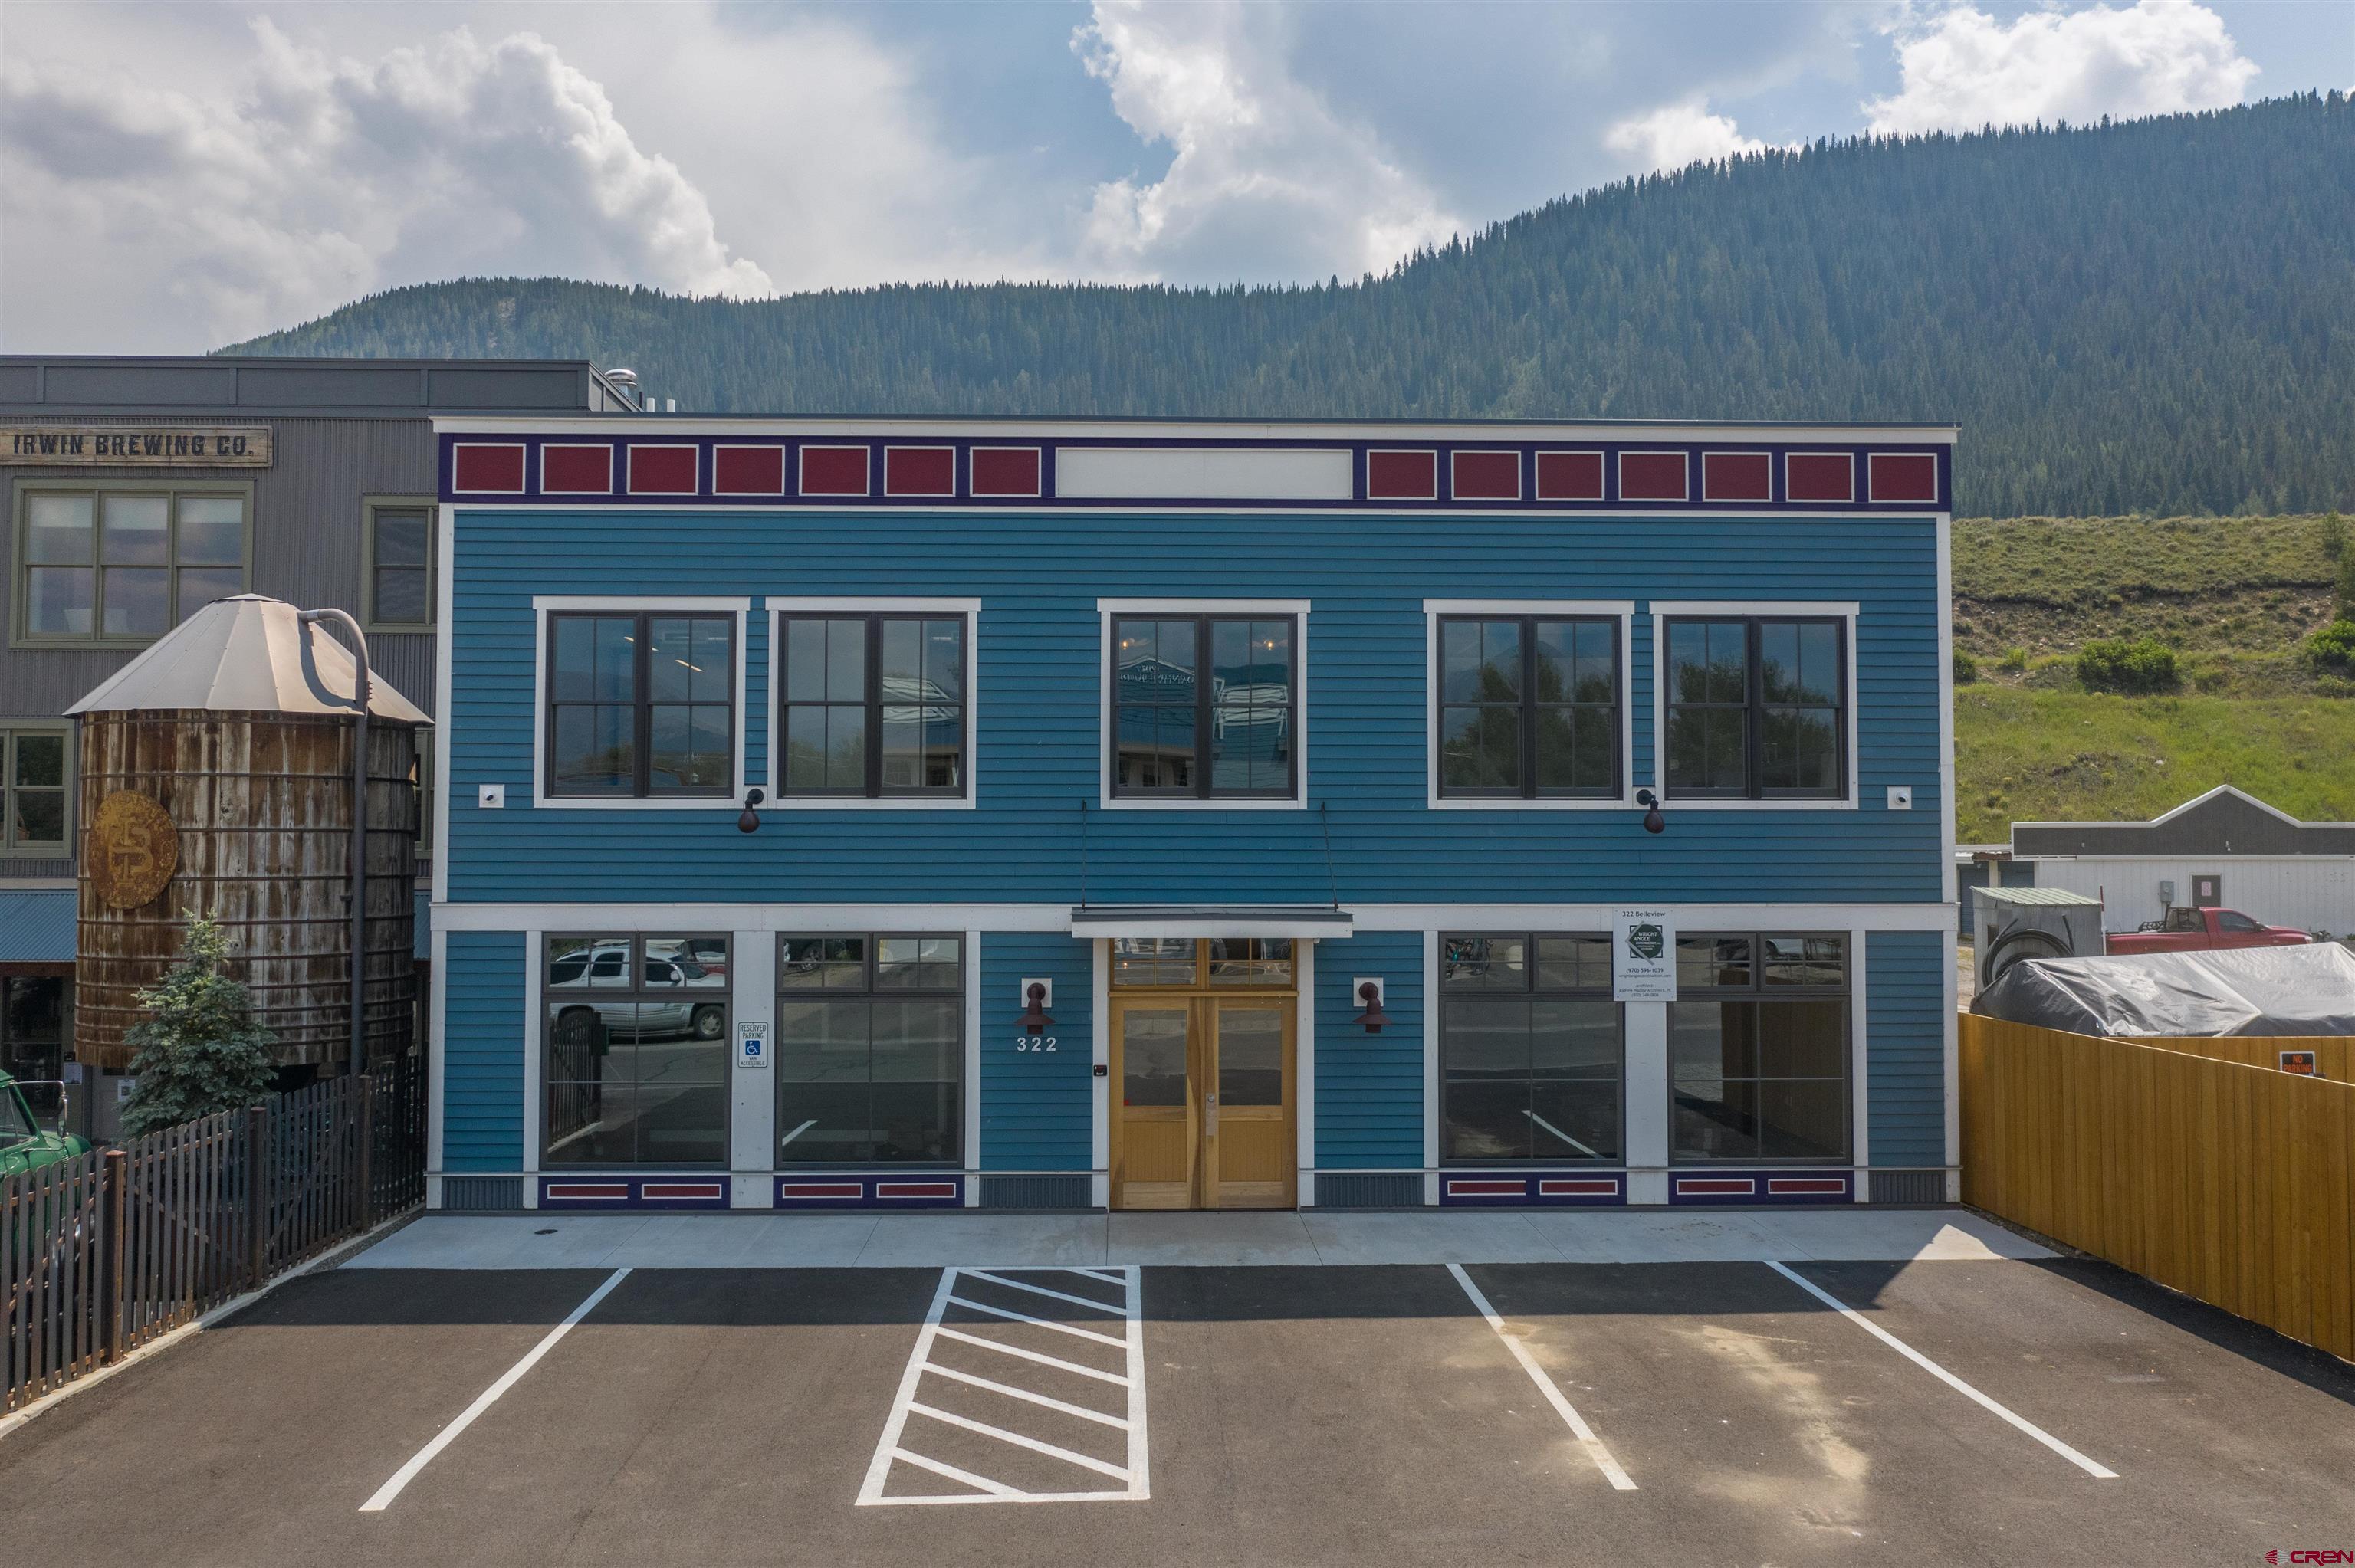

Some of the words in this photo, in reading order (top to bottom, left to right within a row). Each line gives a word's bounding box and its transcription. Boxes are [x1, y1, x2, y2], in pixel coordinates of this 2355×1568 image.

[14, 434, 84, 455] IRWIN
[95, 435, 205, 456] BREWING
[216, 435, 255, 457] CO.
[1017, 1037, 1056, 1051] 322
[2292, 1055, 2303, 1064] NO
[2283, 1064, 2312, 1074] PARKING
